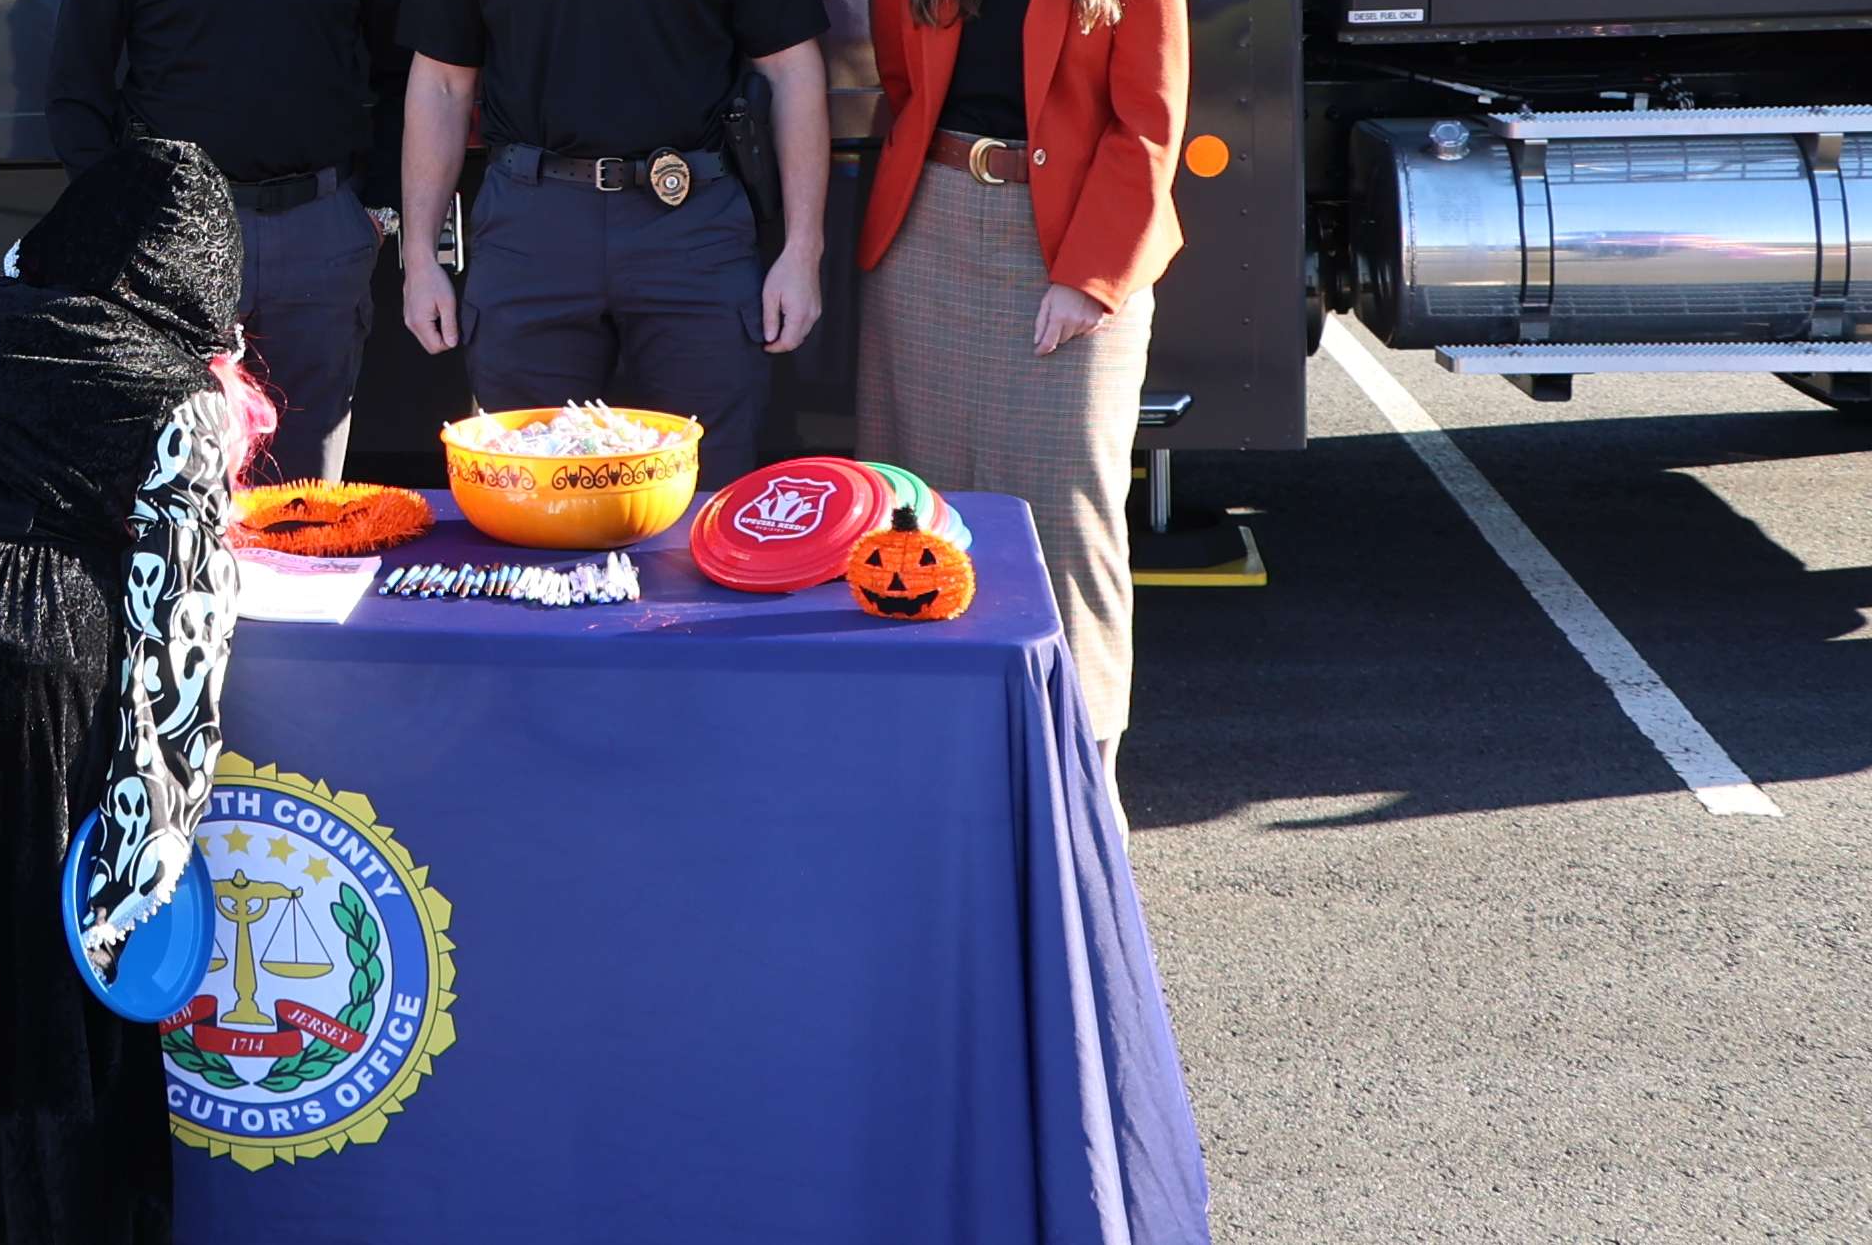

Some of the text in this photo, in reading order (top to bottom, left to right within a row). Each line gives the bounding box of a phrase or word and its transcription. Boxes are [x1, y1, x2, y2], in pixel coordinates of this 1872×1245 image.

[1380, 12, 1397, 20] FUEL
[273, 799, 403, 901] COUNTY
[161, 1002, 354, 1046] NEW JERSEY
[230, 1037, 264, 1053] 1714
[166, 992, 422, 1133] CUTOR'S OFFICE
